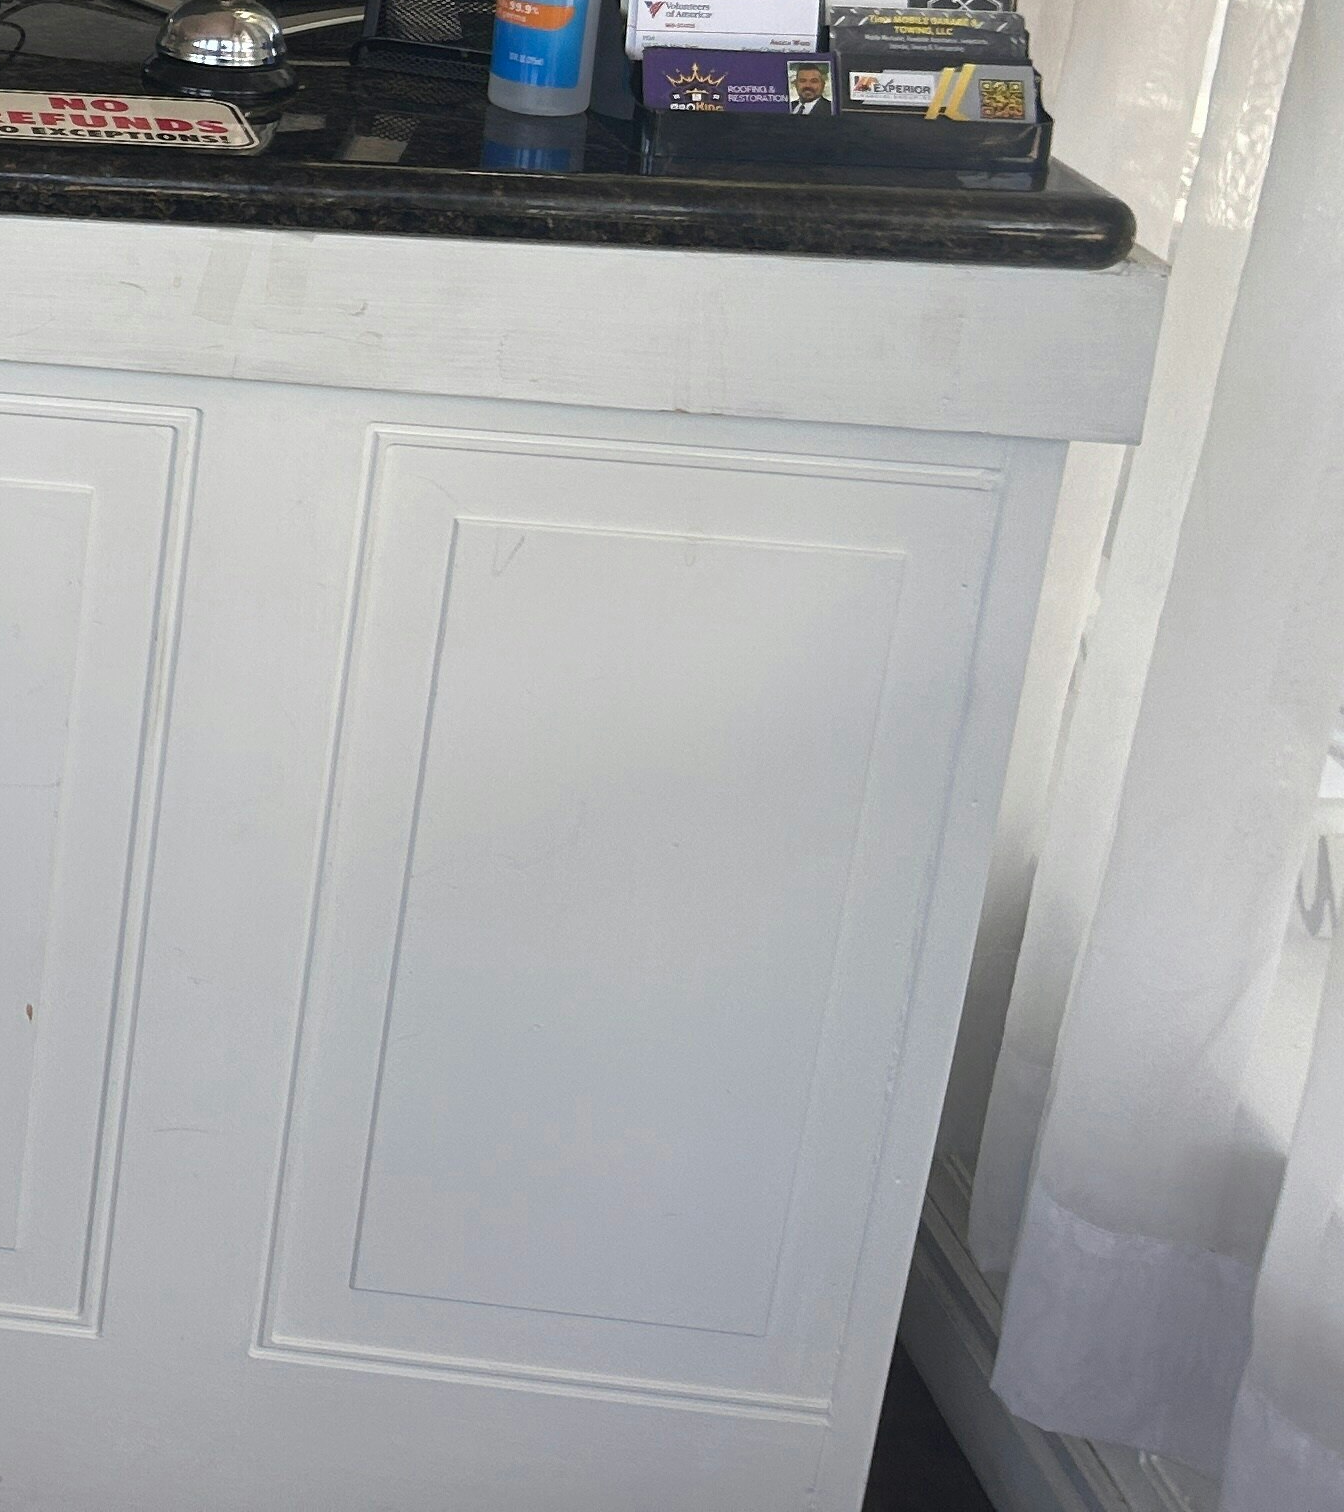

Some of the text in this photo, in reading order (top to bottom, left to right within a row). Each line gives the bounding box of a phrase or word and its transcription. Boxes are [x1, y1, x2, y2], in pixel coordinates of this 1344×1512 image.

[665, 1, 710, 10] Volunteers
[936, 27, 953, 35] LLC
[728, 85, 775, 94] ROOFING &
[874, 81, 930, 94] EXPERIOR
[728, 94, 788, 102] RESTORATION
[48, 97, 130, 112] NO
[32, 126, 231, 144] EXCEPTIONS!
